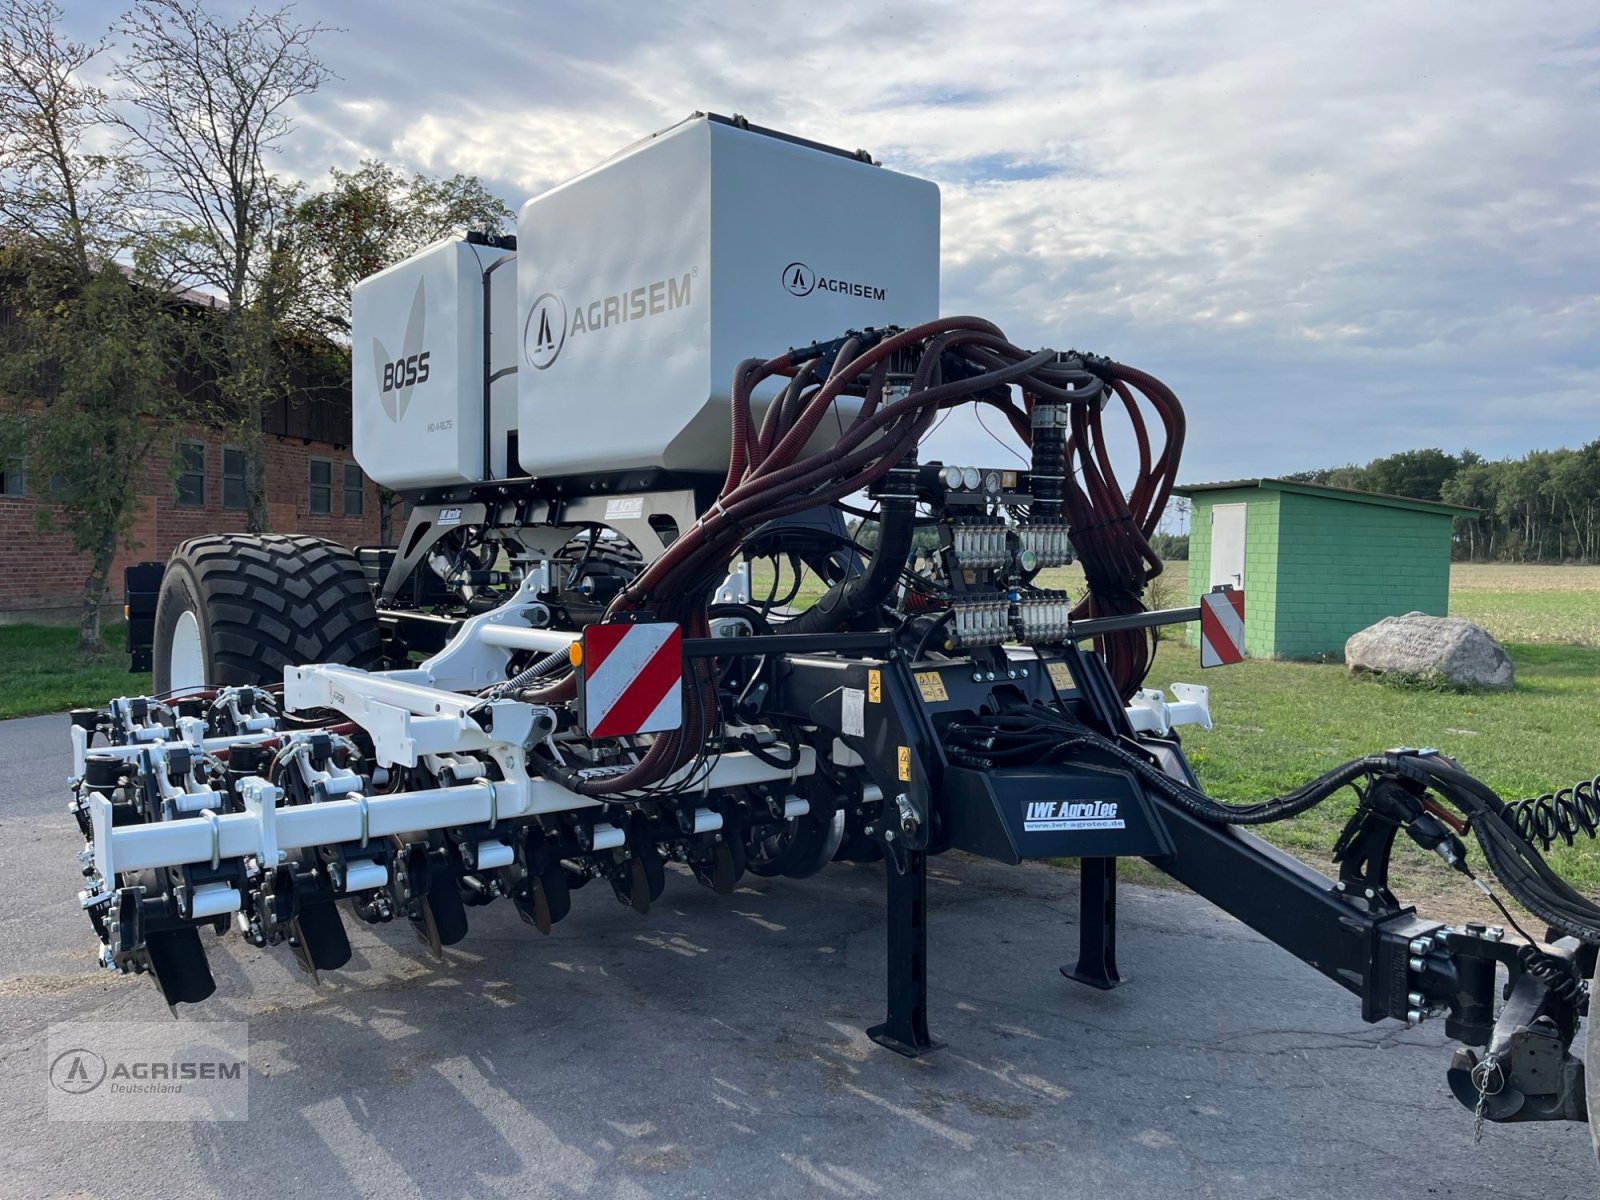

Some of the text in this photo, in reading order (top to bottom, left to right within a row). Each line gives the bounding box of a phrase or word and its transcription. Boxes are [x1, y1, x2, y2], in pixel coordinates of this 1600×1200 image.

[818, 277, 886, 301] AGRISEM
[570, 273, 691, 338] AGRISEM
[383, 352, 430, 392] BOSS
[1026, 801, 1118, 820] LWF AgroTec
[1026, 821, 1123, 829] www.lwf-agrotec.de
